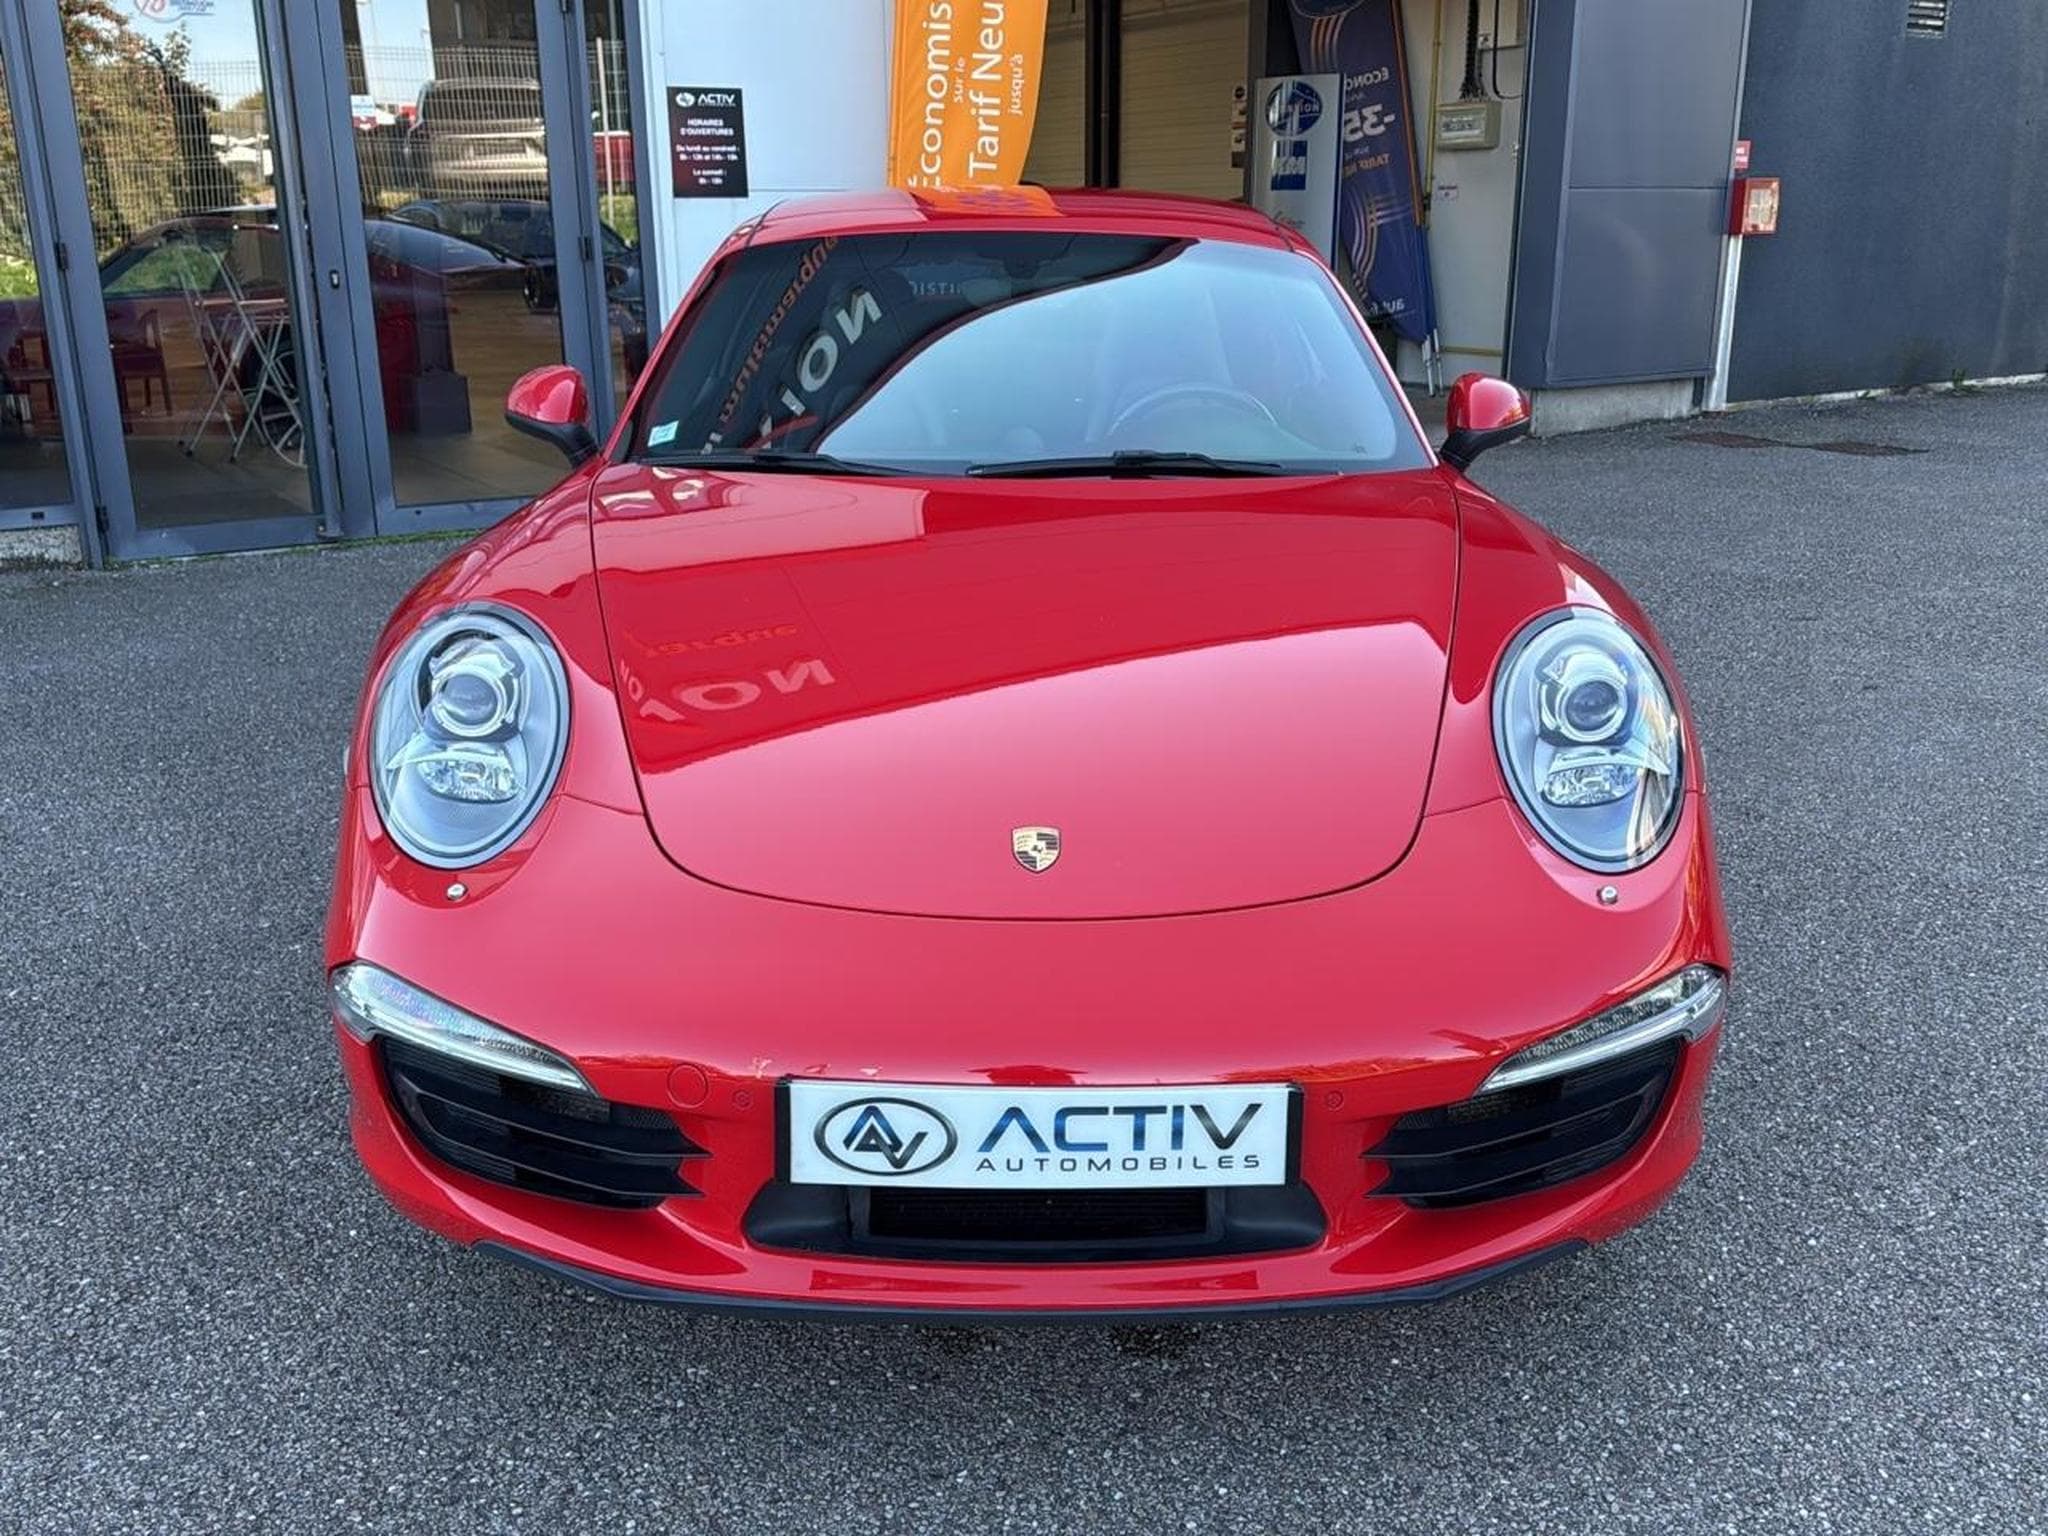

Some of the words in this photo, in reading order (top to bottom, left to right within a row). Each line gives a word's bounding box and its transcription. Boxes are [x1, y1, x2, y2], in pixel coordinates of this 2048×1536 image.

[971, 1, 1005, 81] Neu
[953, 57, 966, 72] le
[697, 94, 736, 104] ACTIV
[953, 77, 965, 103] sur
[687, 118, 724, 127] HORAIRES
[967, 89, 1001, 178] Tarif
[976, 1102, 1263, 1154] ACTIV
[976, 1154, 1261, 1173] AUTOMOBILES
